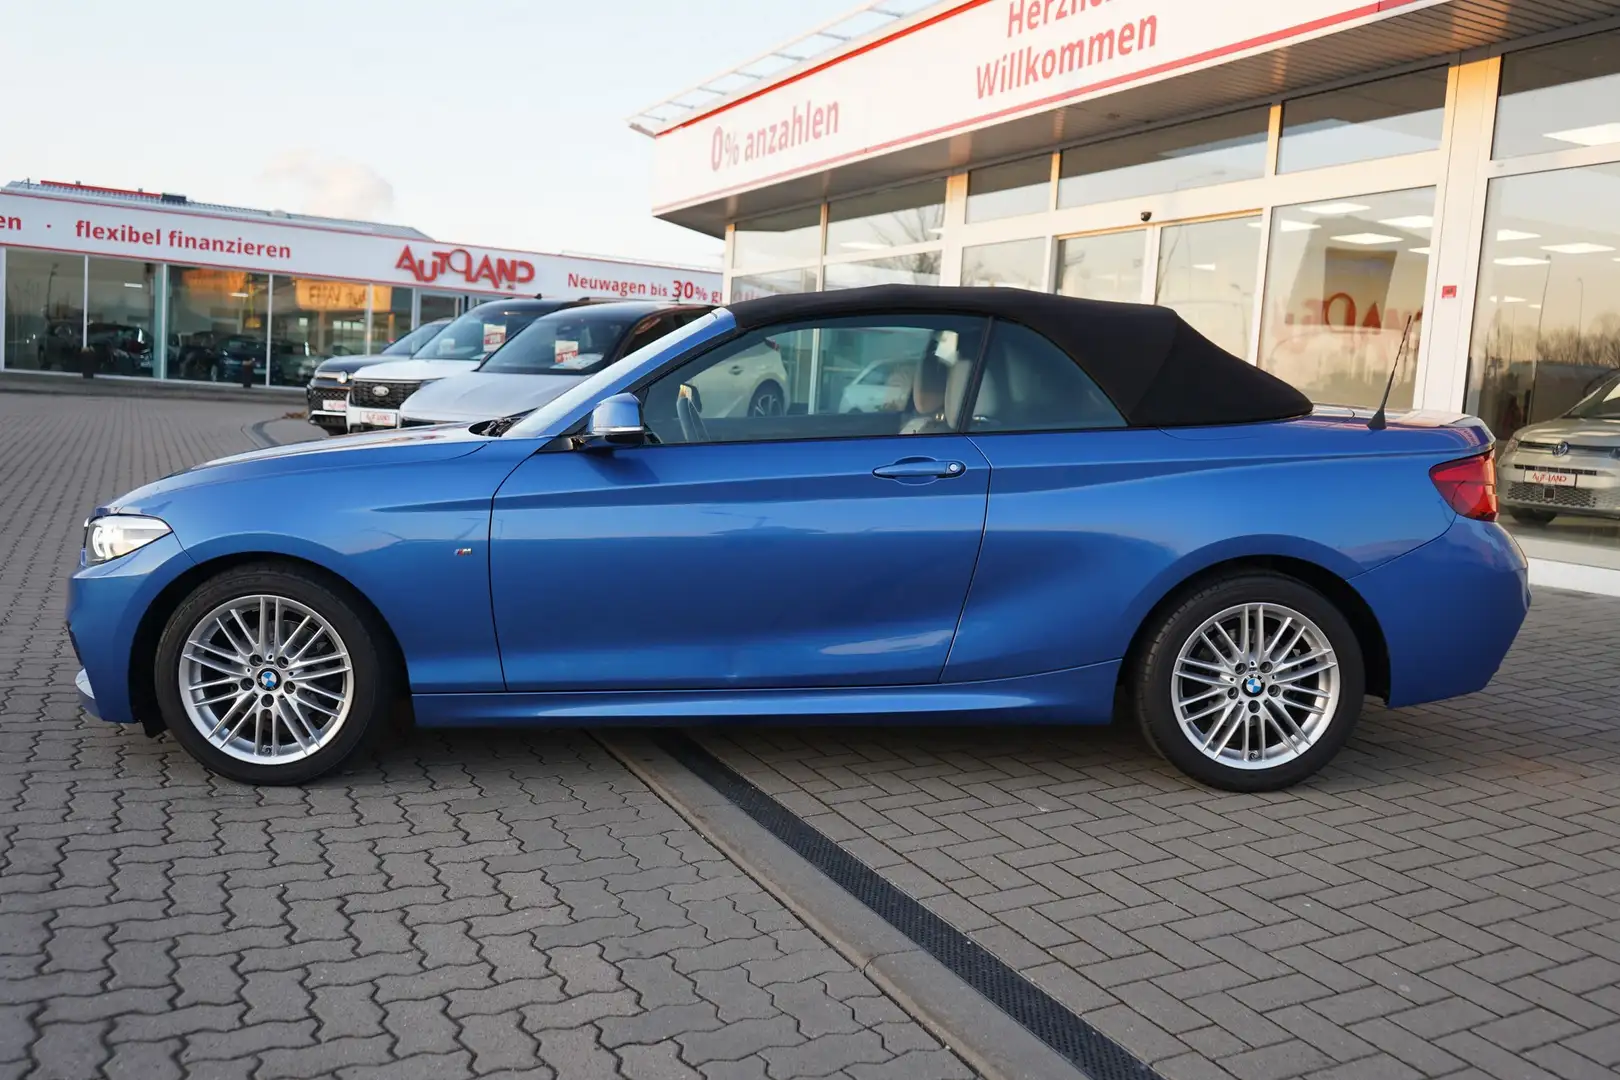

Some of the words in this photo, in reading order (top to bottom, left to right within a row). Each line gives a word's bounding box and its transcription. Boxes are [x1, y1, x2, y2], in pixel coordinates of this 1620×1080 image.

[976, 14, 1157, 99] Willkommen
[711, 125, 739, 171] 0%
[745, 100, 839, 162] anzahlen
[76, 220, 161, 246] flexibel
[168, 230, 291, 258] finanzieren
[567, 273, 646, 297] Neuwagen
[650, 284, 668, 297] bis
[672, 280, 707, 300] 30%
